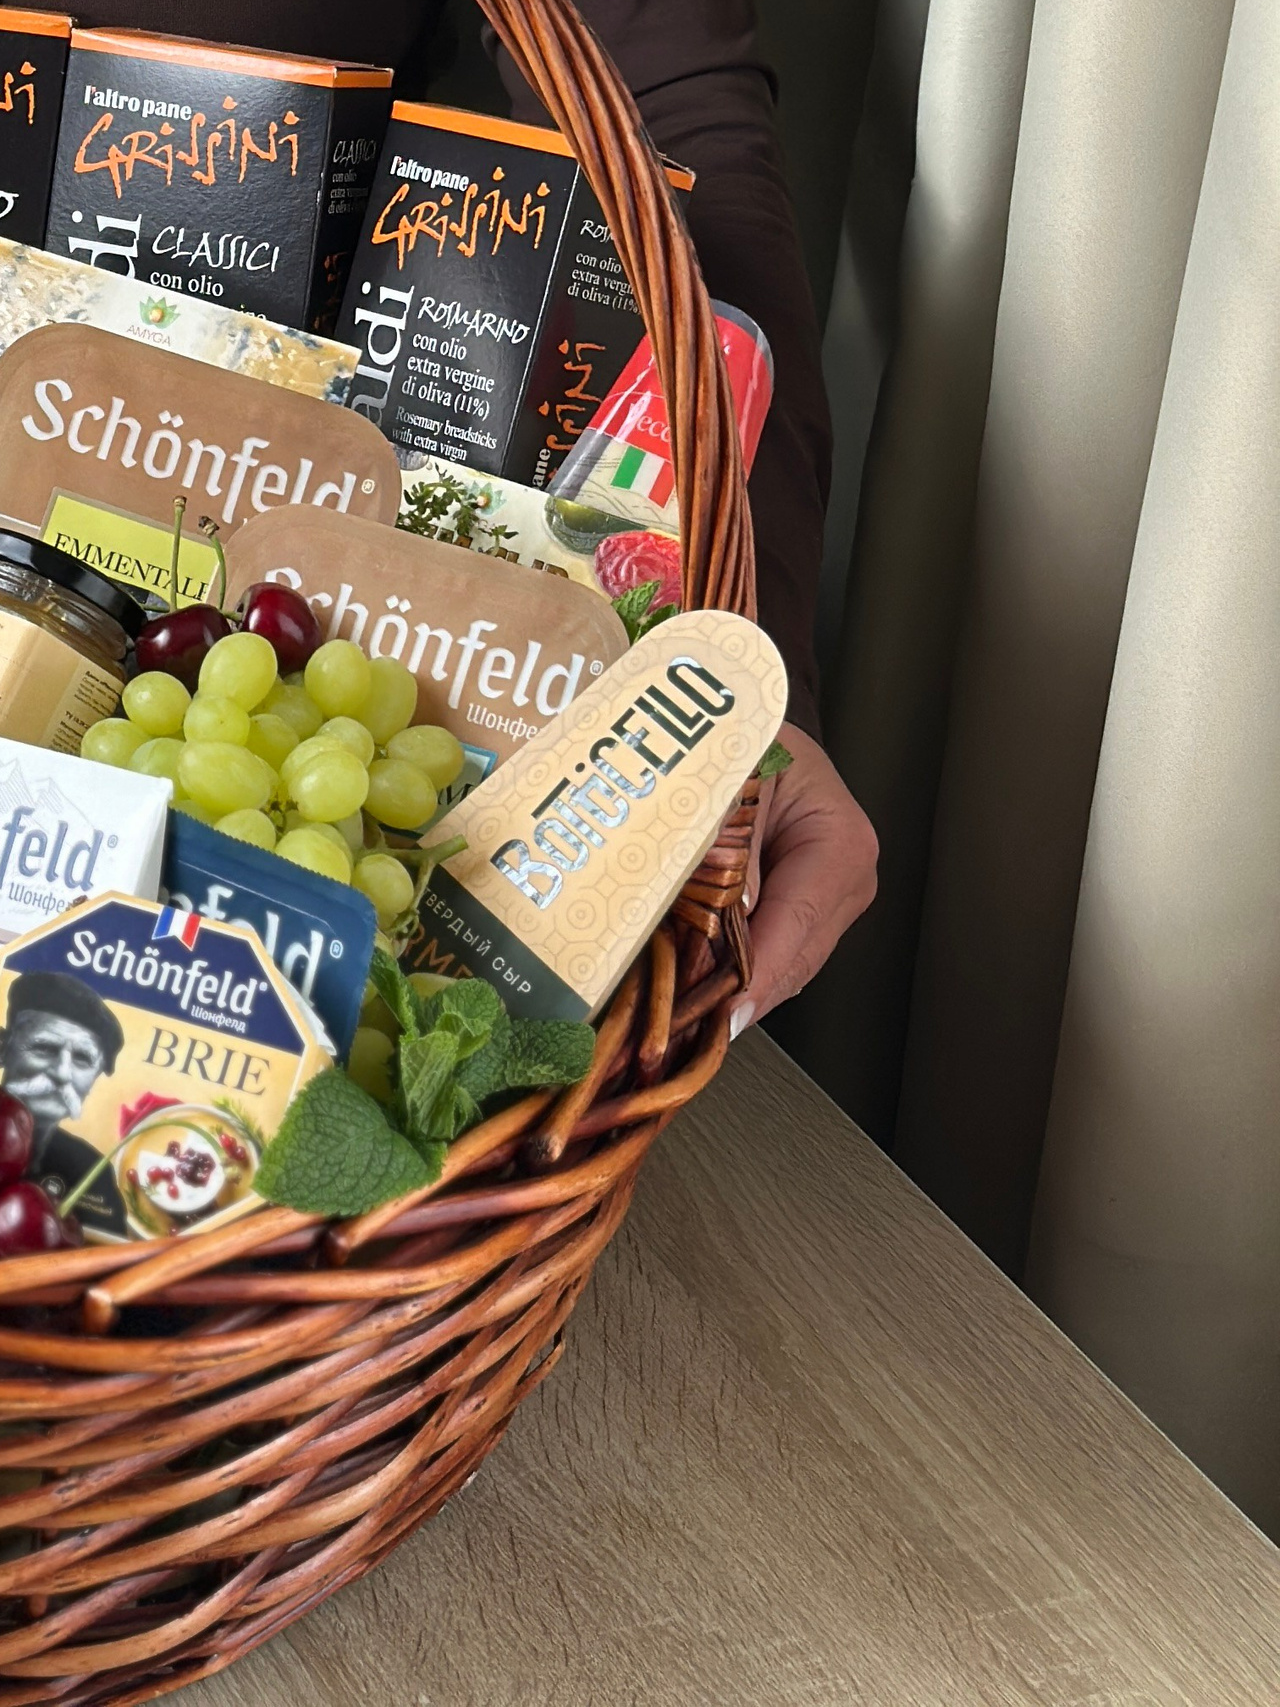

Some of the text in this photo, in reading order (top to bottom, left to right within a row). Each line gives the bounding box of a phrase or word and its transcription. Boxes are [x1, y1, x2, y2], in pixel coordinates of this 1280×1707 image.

[141, 98, 193, 121] pane
[433, 167, 471, 191] pane
[151, 225, 280, 273] CLASSICI
[576, 251, 622, 274] con olio
[149, 270, 224, 298] con olio
[571, 267, 603, 286] extra
[567, 284, 580, 298] di
[582, 286, 611, 307] oliva
[125, 323, 173, 346] AMYGA
[418, 296, 531, 344] ROSMARINO
[412, 332, 467, 361] con olio
[407, 355, 495, 393] extra vergine
[401, 376, 491, 421] di oliva (11%)
[392, 426, 468, 462] with extra virgin
[395, 405, 498, 450] Rosemary breadsticks
[531, 448, 551, 490] ane
[466, 701, 542, 743] Шонфе
[8, 881, 72, 916] Шонфе
[66, 930, 258, 1016] Schönfeld
[491, 956, 533, 994] СЫР
[190, 1004, 247, 1034] Шонфелд
[142, 1026, 271, 1096] BRIE
